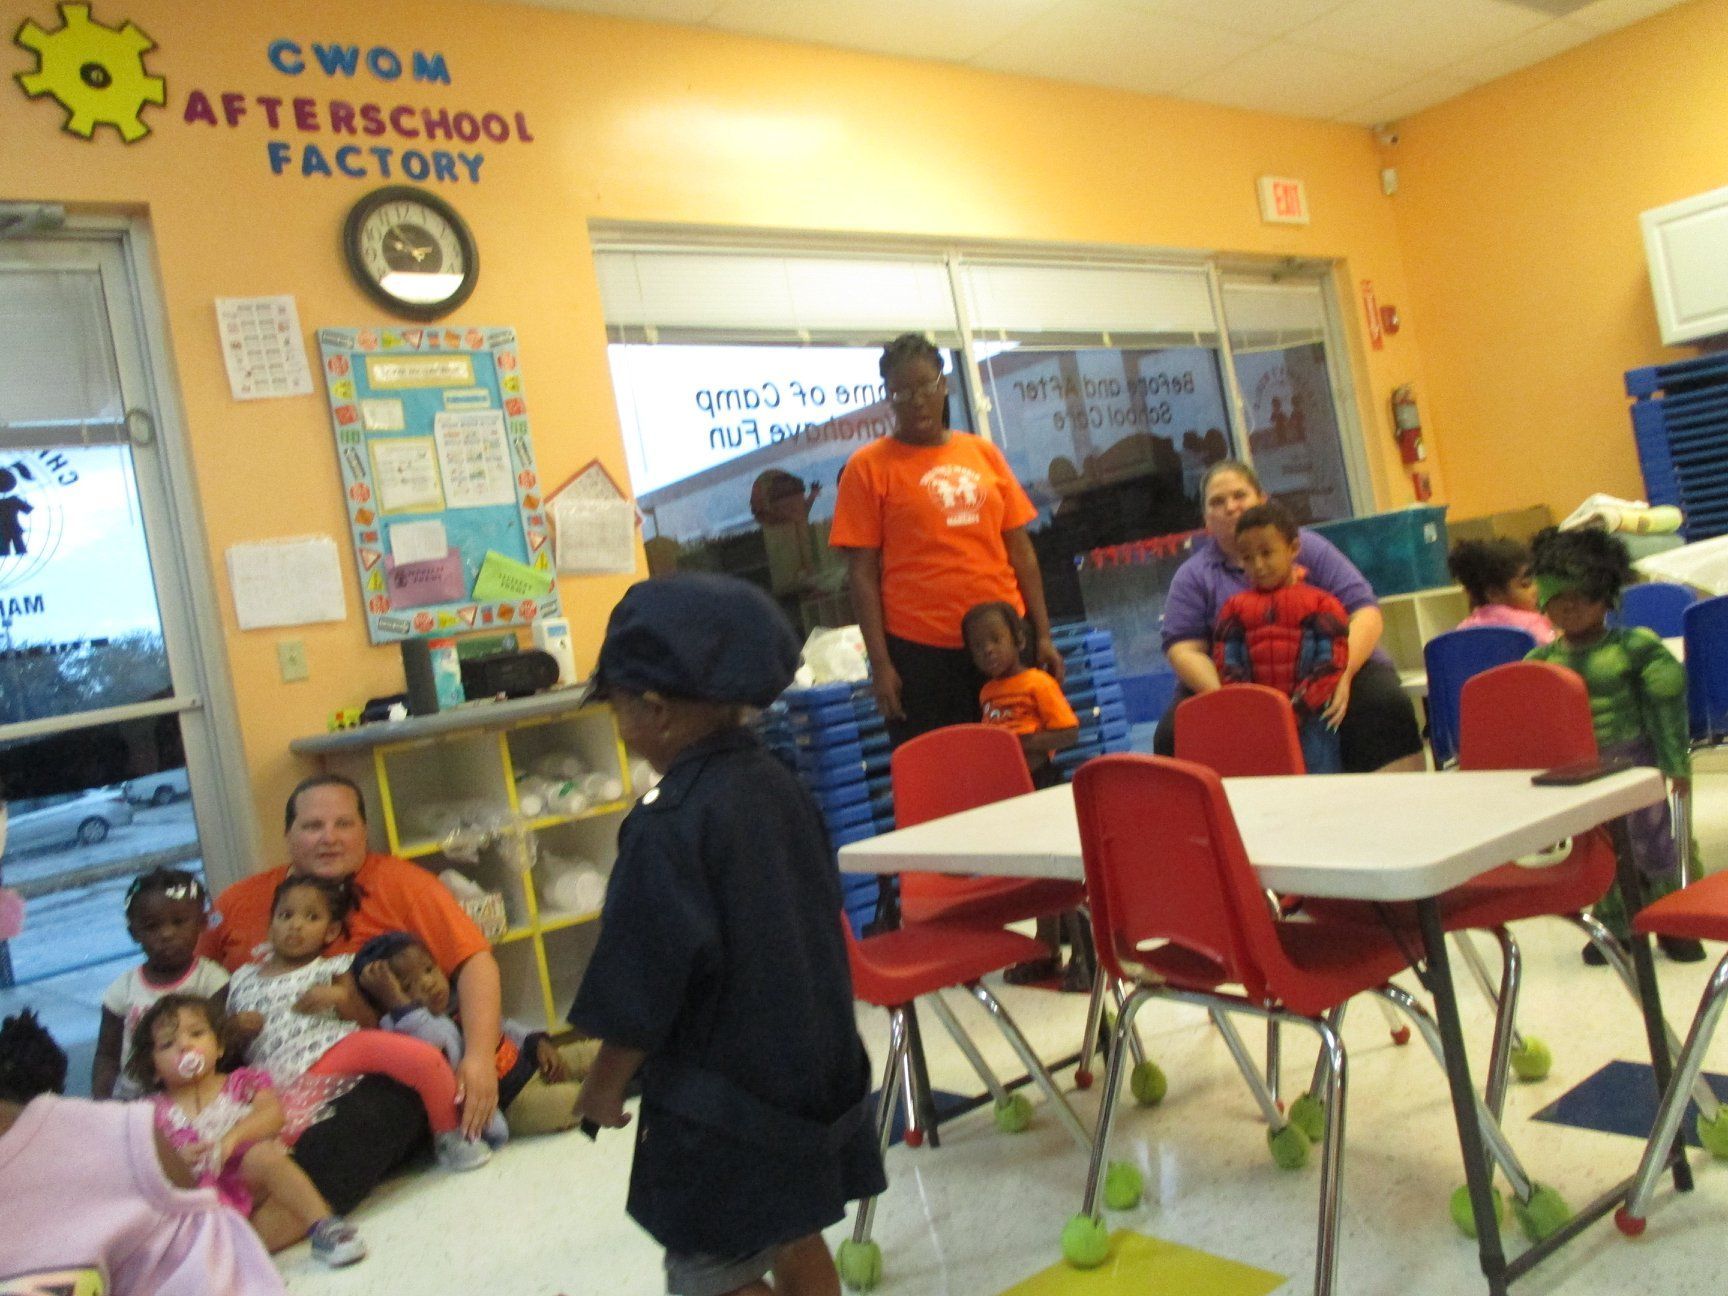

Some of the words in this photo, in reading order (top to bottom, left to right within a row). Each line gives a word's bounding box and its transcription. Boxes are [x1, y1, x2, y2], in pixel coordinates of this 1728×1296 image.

[267, 39, 452, 85] CWOM
[184, 89, 534, 143] AFTERSCHOOL
[267, 142, 484, 184] FACTORY
